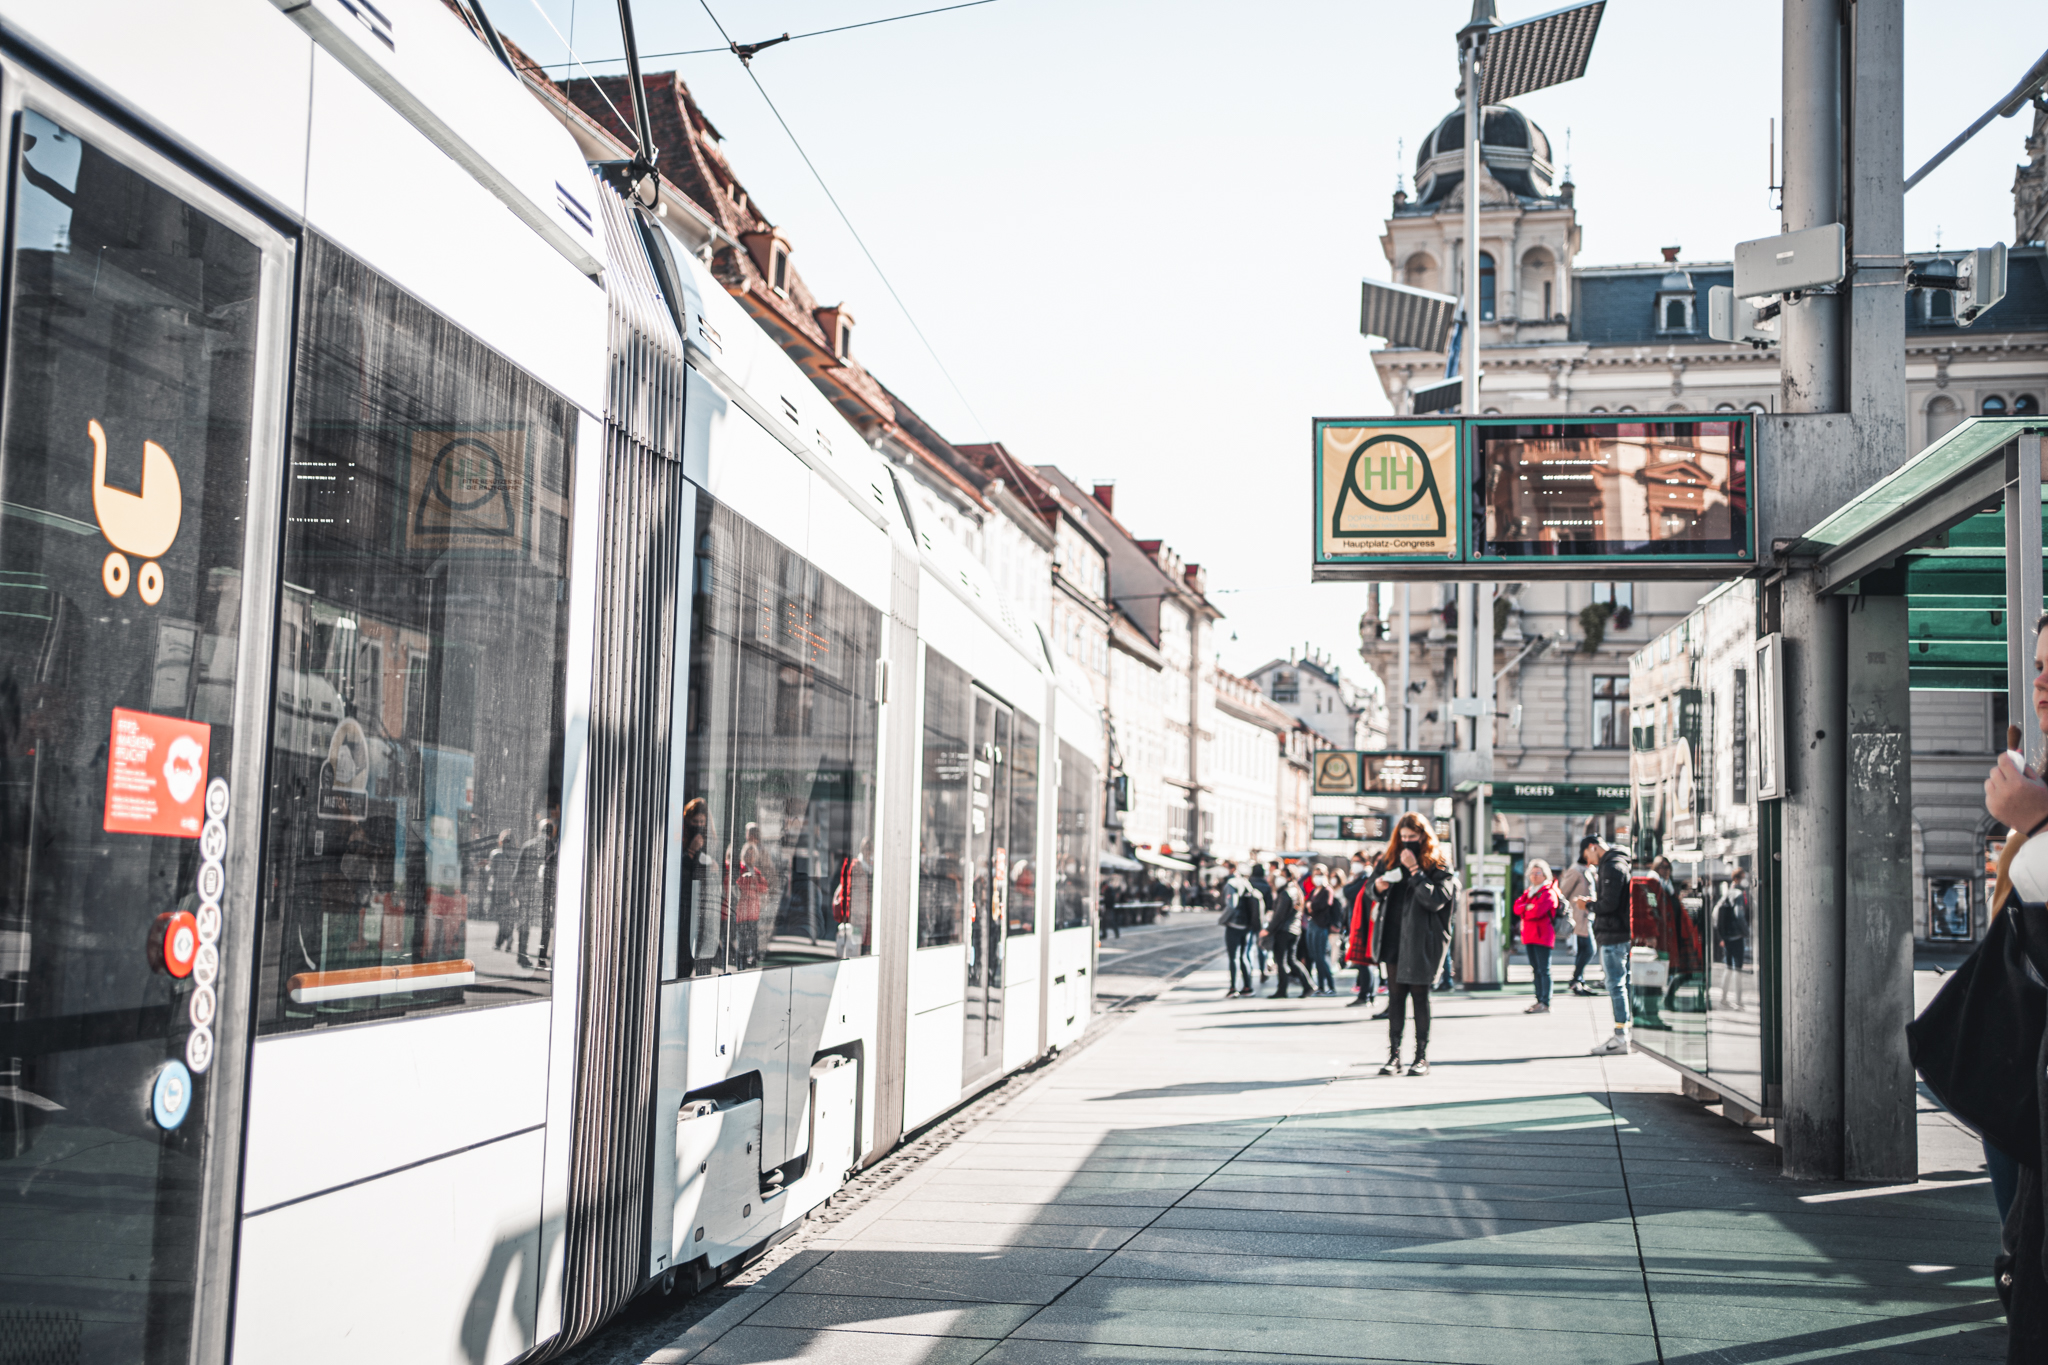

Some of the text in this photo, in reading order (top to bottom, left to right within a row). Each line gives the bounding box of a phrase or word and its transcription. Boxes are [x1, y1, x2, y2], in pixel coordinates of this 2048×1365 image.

[1364, 456, 1414, 491] HH
[1347, 513, 1431, 522] DOPPELHALTESTELLE
[1343, 538, 1435, 550] Hauptplatz-Congress
[1514, 785, 1555, 797] TICKETS
[1596, 786, 1631, 798] TICKET
